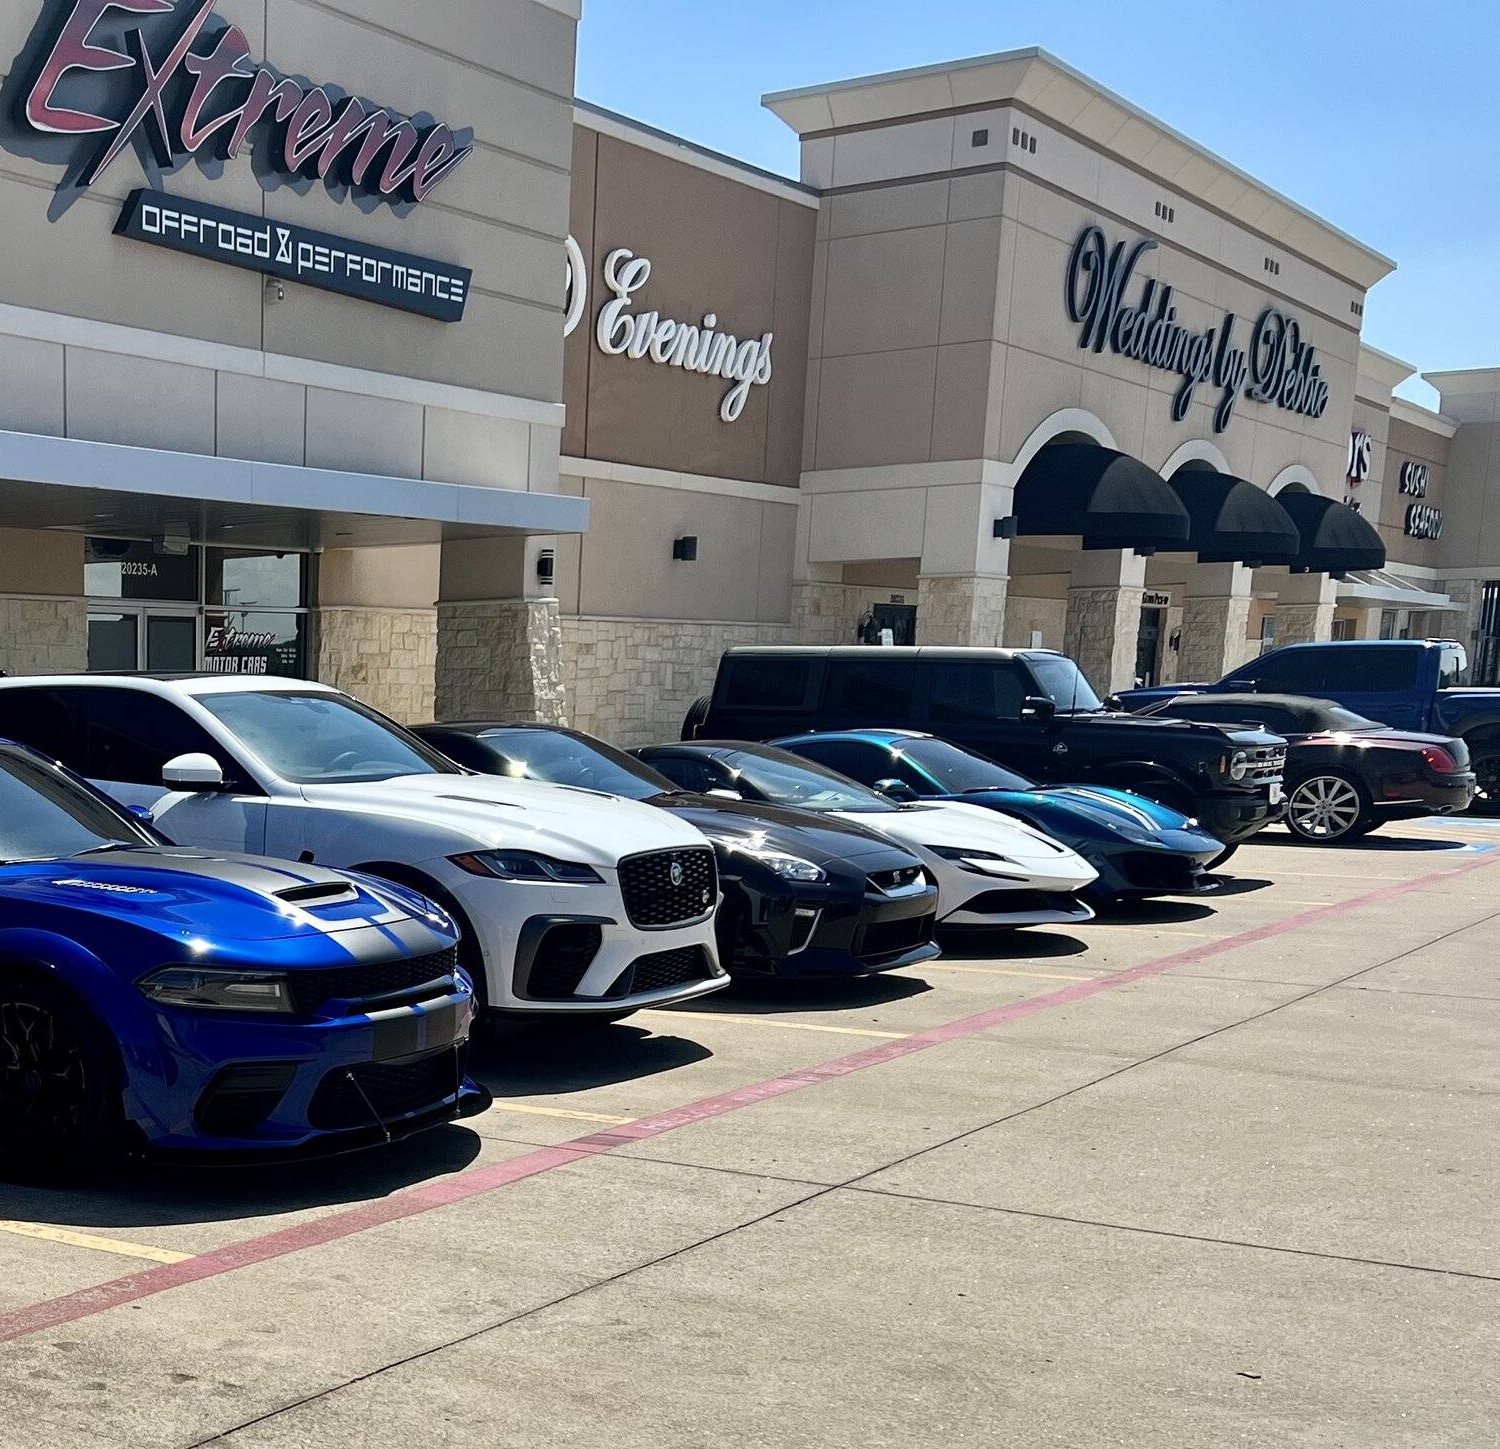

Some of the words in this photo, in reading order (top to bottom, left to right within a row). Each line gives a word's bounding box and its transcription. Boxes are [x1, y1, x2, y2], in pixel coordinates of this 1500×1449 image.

[275, 227, 293, 264] &
[597, 248, 773, 422] Evenings
[1065, 225, 1217, 423] Weddings
[1212, 312, 1247, 433] by
[1245, 307, 1329, 418] Debbie
[1399, 460, 1430, 498] SUSHI
[121, 561, 158, 577] 20235-A
[204, 656, 239, 672] MOTOR
[241, 656, 267, 674] CARS
